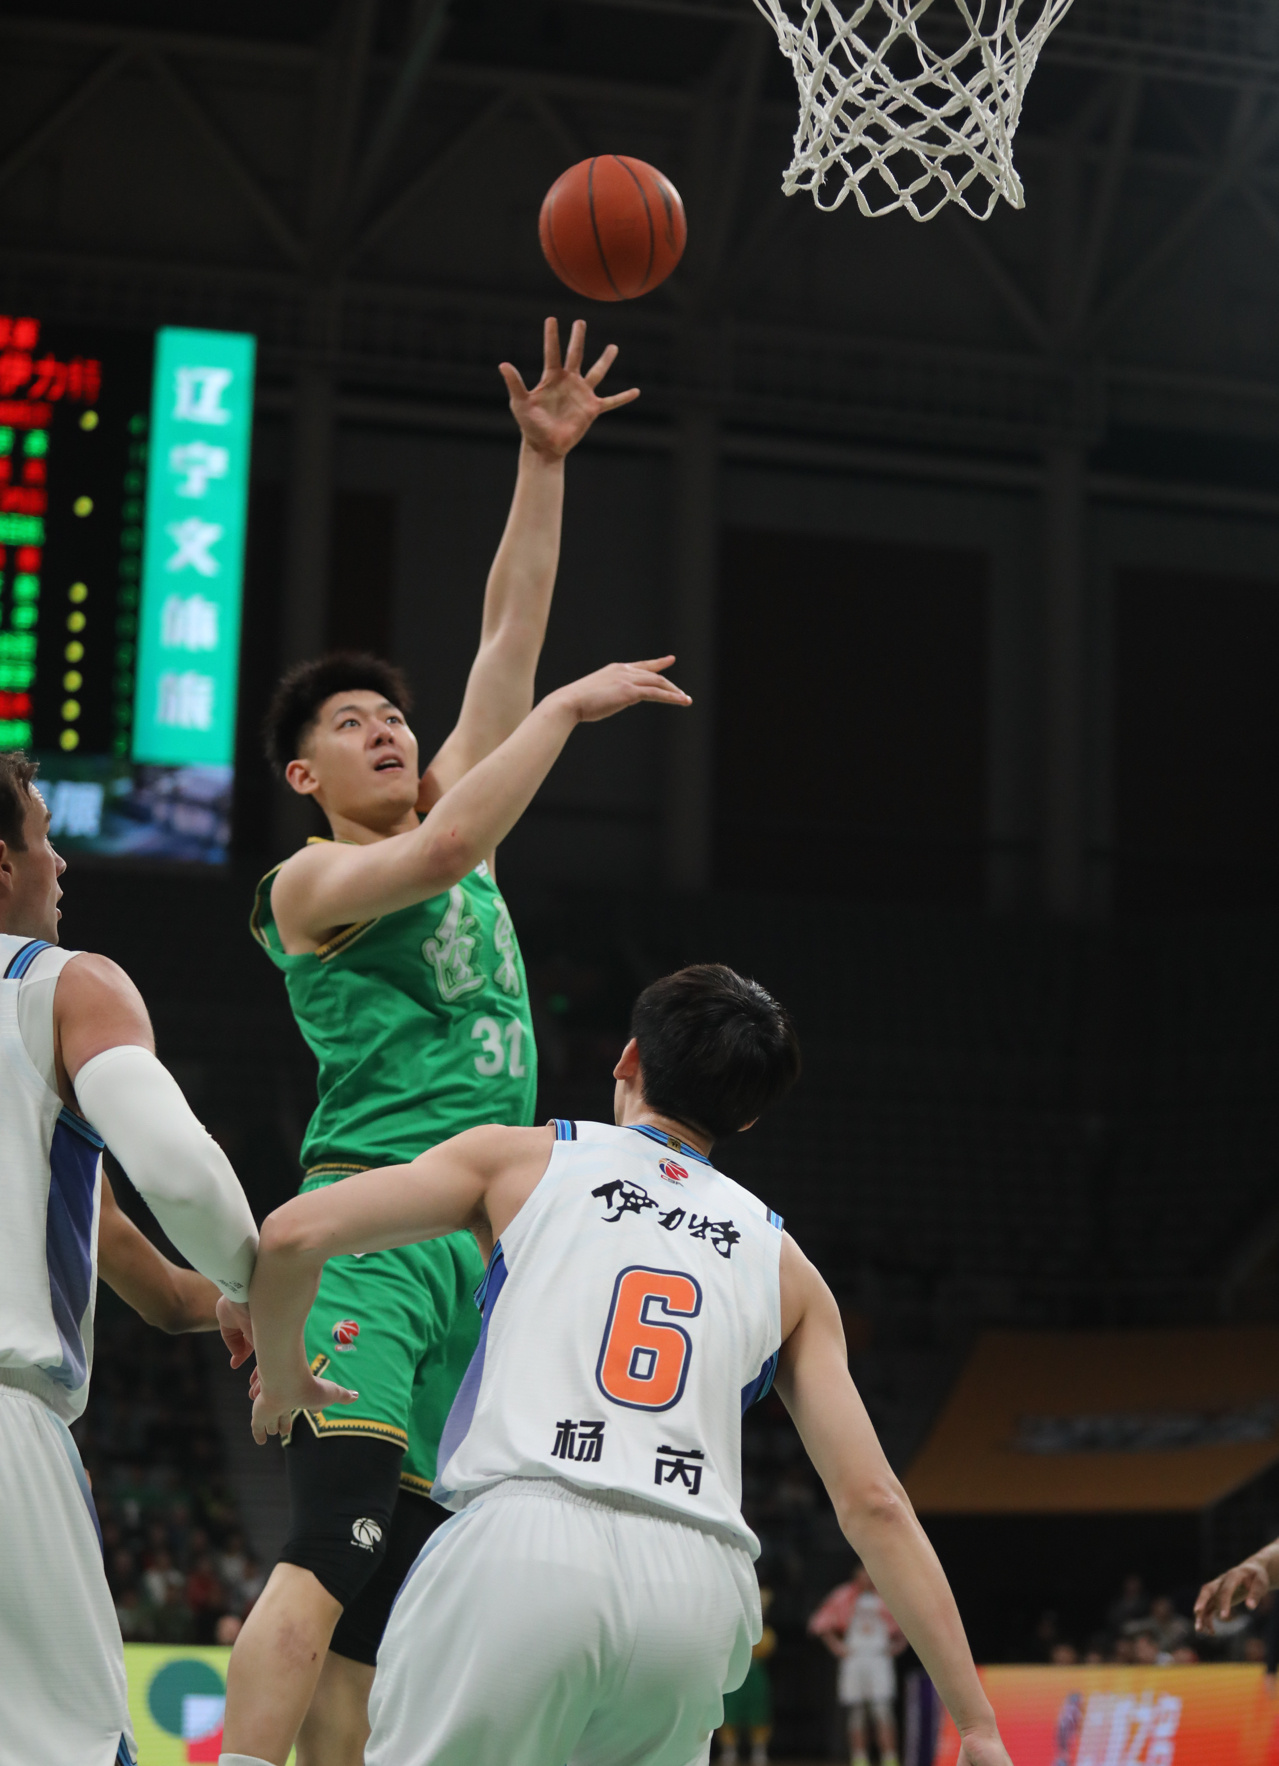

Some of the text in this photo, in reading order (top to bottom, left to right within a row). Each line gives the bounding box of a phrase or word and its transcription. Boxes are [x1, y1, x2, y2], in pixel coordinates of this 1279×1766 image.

[591, 1179, 741, 1259] 伊力特
[595, 1265, 702, 1412] 6
